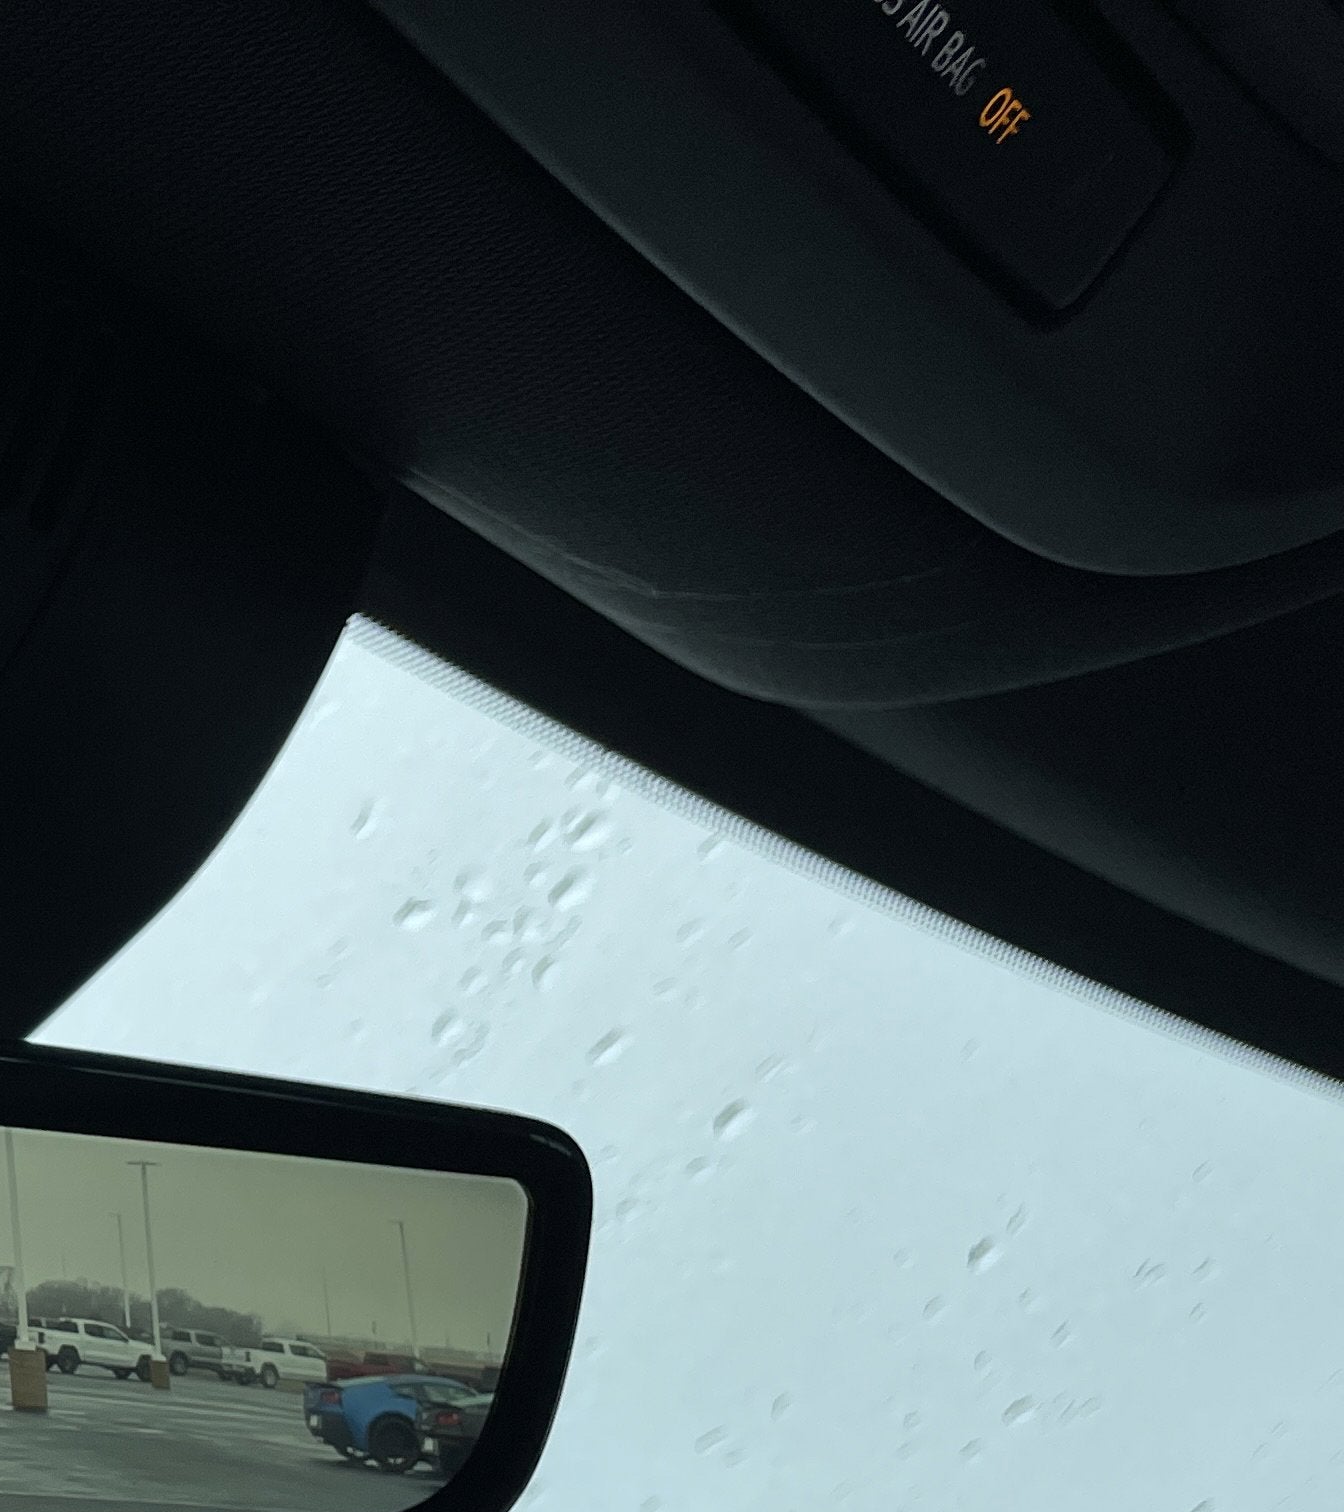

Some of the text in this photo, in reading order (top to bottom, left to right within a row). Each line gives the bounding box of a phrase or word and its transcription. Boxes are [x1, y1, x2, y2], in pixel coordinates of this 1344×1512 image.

[896, 0, 1031, 144] AIR BAG OFF
